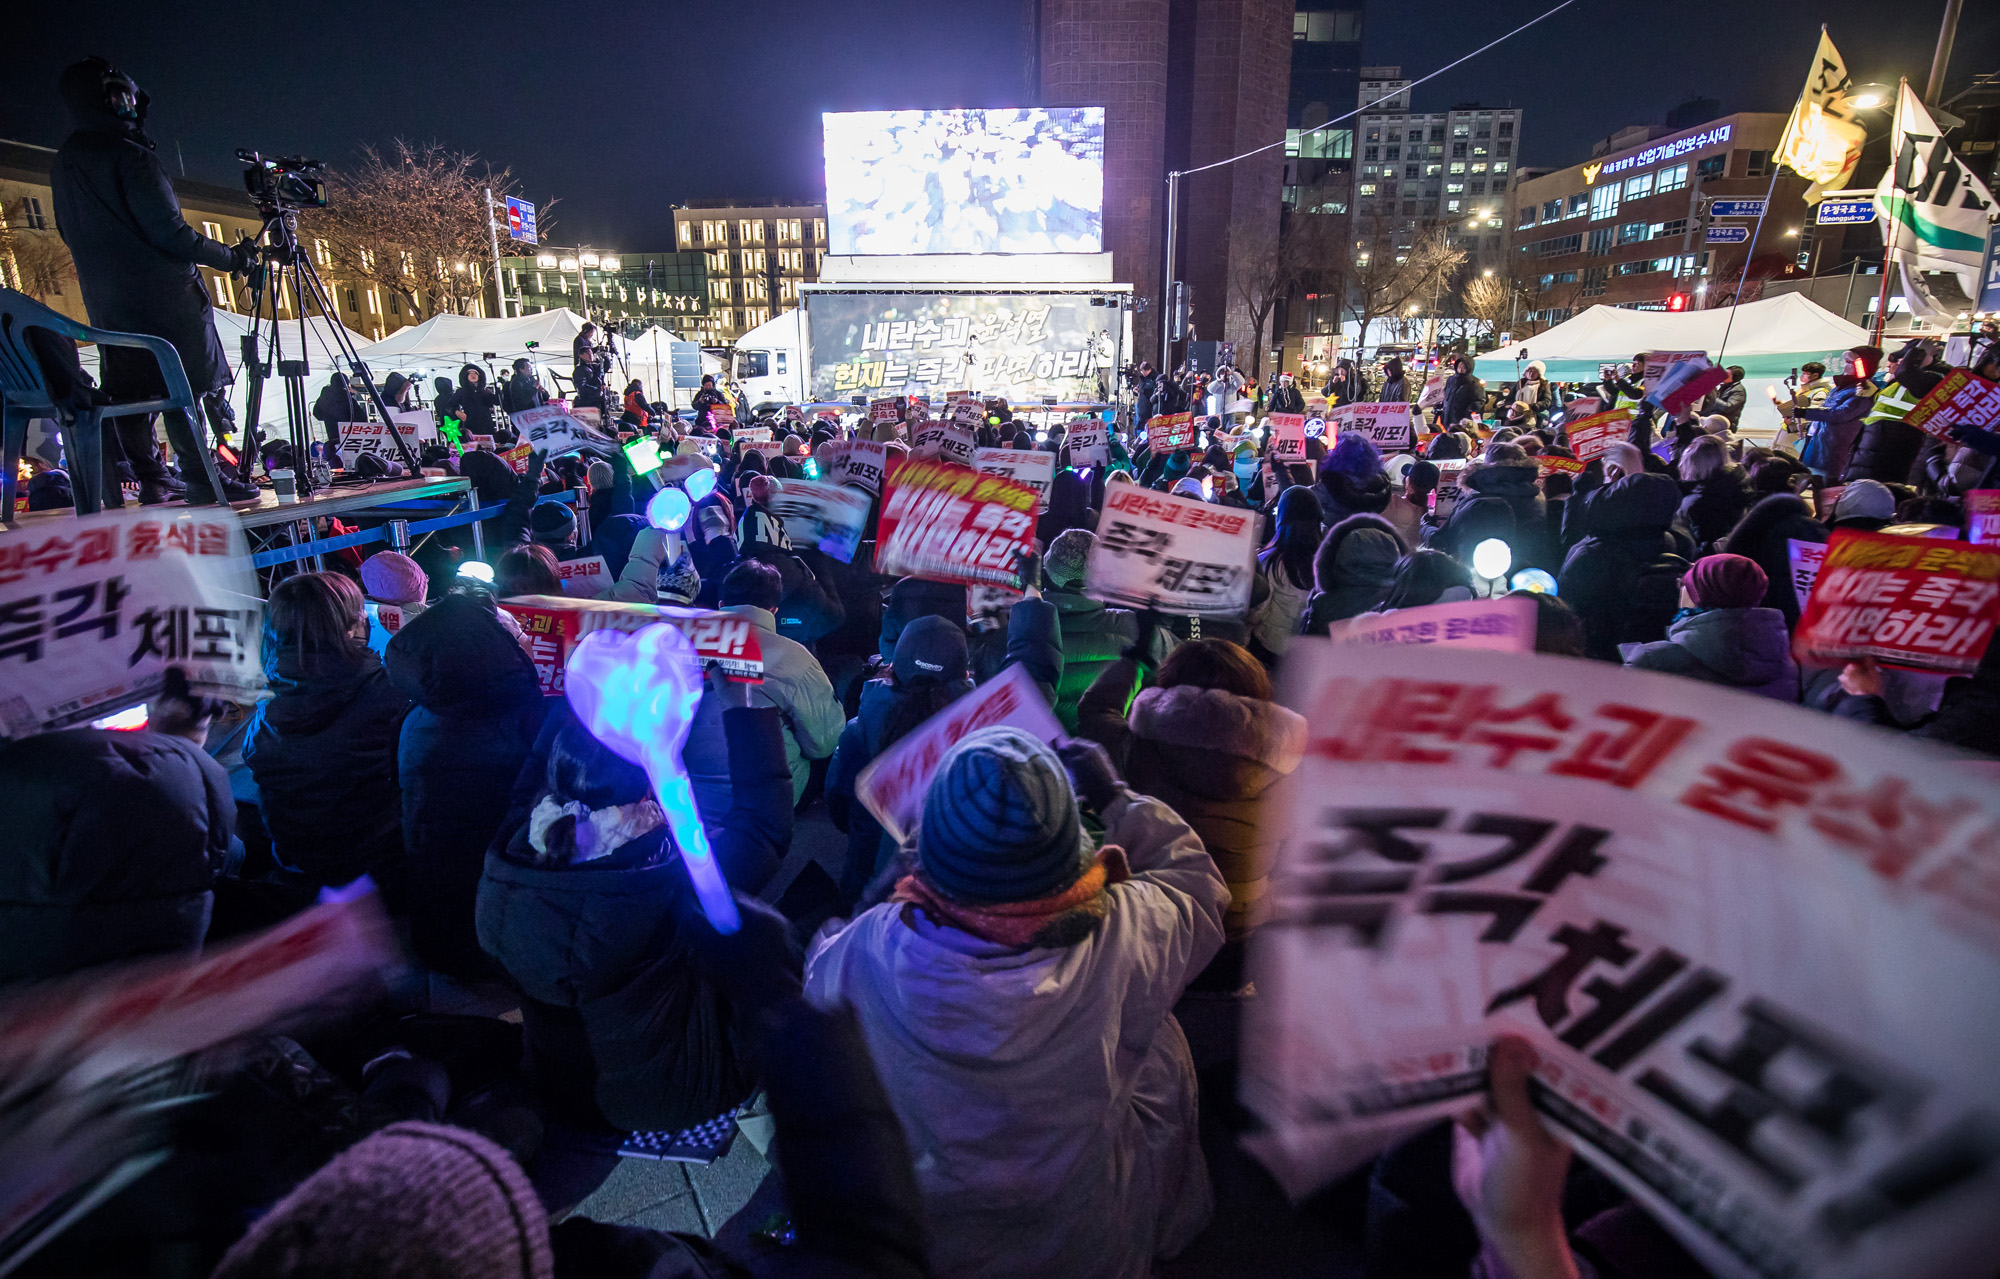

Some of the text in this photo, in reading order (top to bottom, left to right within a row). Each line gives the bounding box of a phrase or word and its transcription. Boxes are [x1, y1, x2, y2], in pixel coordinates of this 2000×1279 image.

[1636, 124, 1731, 167] 산업기술안보수사대
[1822, 204, 1857, 215] 우정국로
[861, 304, 1051, 351] 내란수괴 윤석열
[834, 361, 909, 391] 헌재는
[915, 357, 967, 384] 즉각
[1935, 372, 1968, 403] 윤석열
[1952, 379, 1987, 409] 즉각
[1353, 405, 1379, 415] 내란수괴
[1380, 405, 1407, 415] 윤석열
[1355, 418, 1377, 432] 즉각
[344, 439, 381, 453] 즉각
[530, 421, 569, 441] 즉각
[914, 430, 945, 448] 즉각
[1371, 426, 1408, 441] 체포!
[846, 462, 883, 483] 체포!
[1107, 491, 1183, 523] 내란수괴
[0, 520, 229, 584] 란수괴 윤석열
[560, 561, 601, 579] 윤석열
[1911, 576, 1998, 614] 즉각
[0, 574, 131, 663] 즉각
[1816, 605, 1992, 655] 파면하라!
[129, 606, 259, 669] 체포!
[1300, 675, 1696, 789] 내란수괴
[1276, 806, 1612, 948] 즉각
